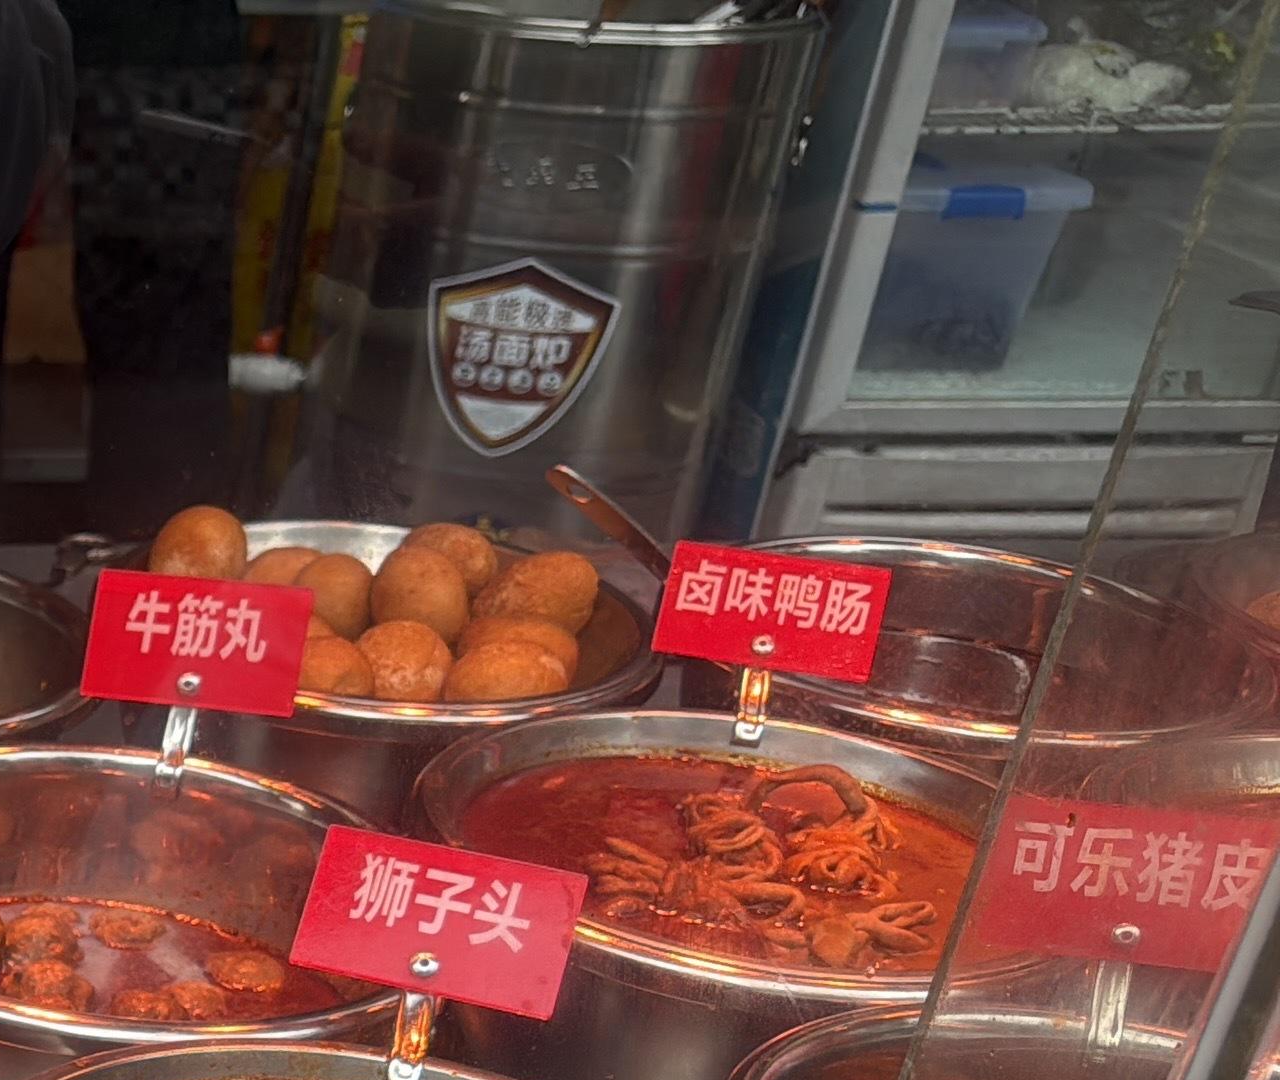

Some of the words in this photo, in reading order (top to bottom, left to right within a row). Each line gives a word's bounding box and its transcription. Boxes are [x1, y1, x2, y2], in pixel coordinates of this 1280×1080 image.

[125, 590, 267, 663] 牛筋丸
[675, 559, 872, 636] 卤味鸭肠
[348, 853, 531, 954] 狮子头
[1013, 821, 1269, 912] 可乐猪皮
